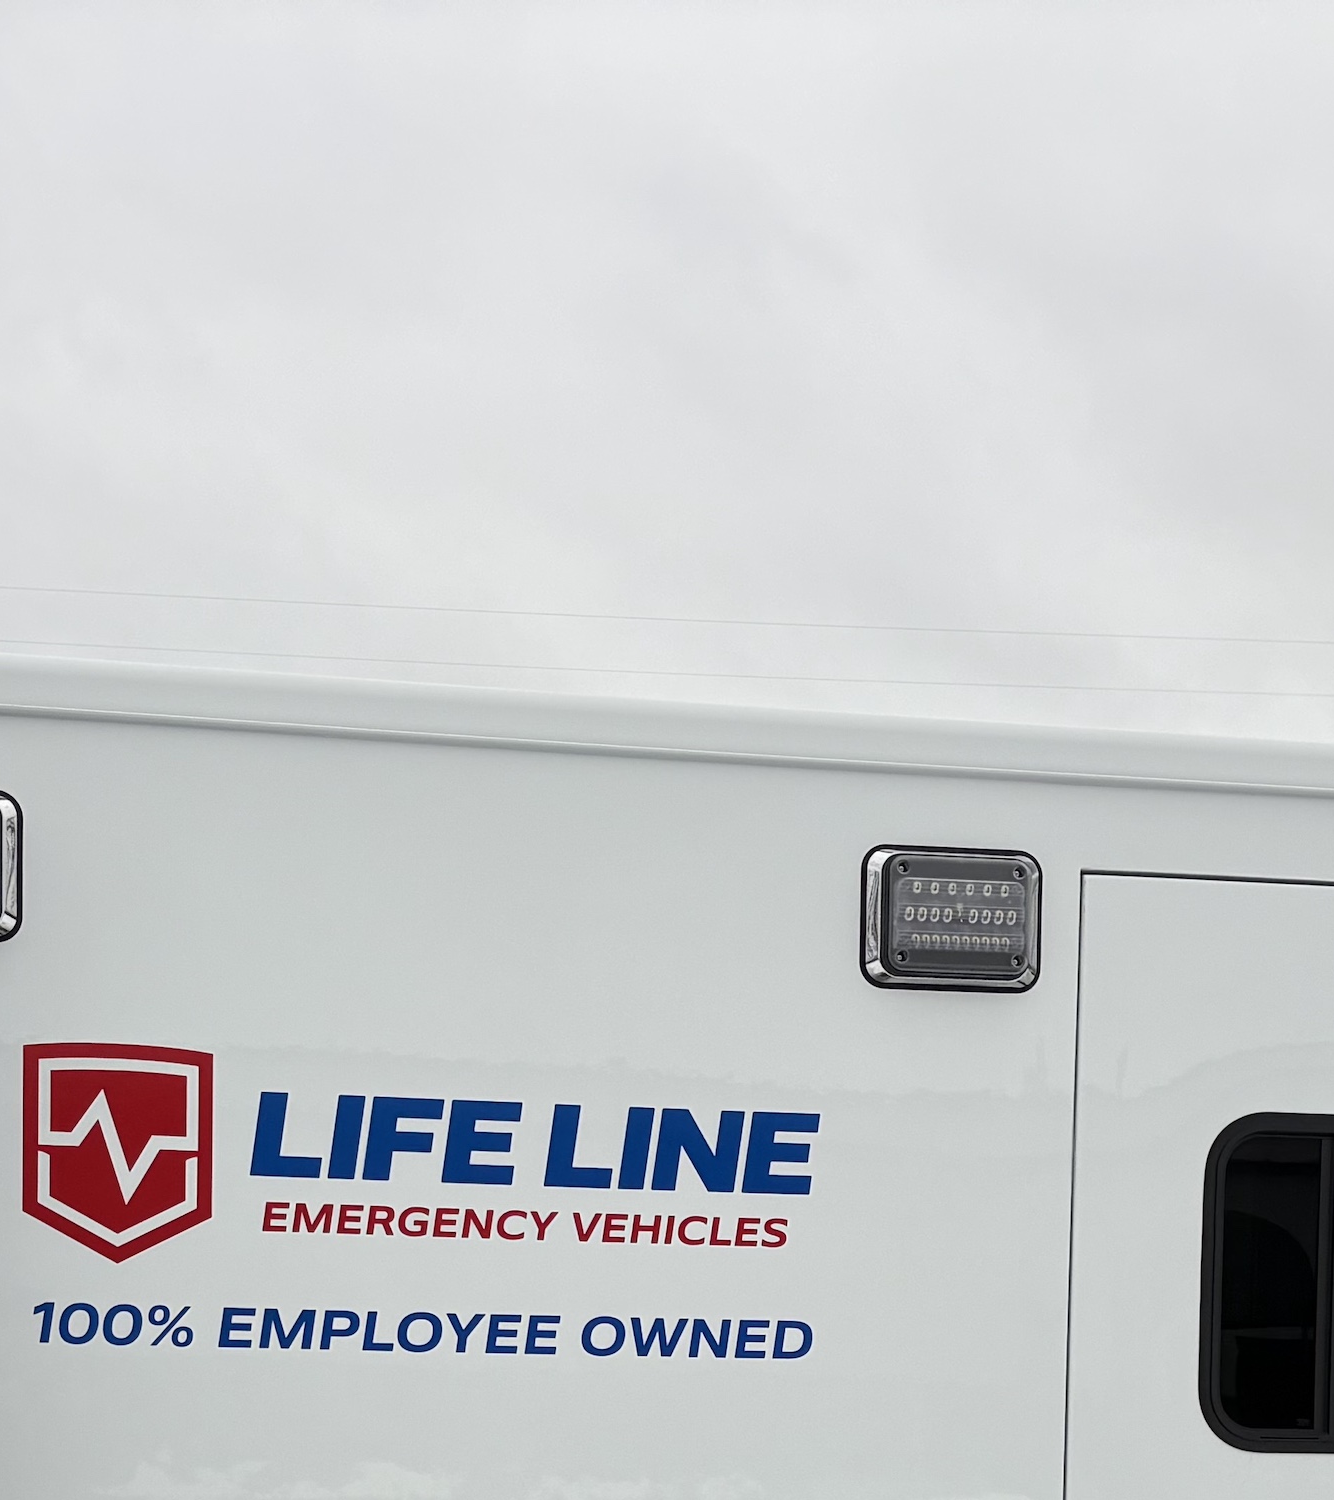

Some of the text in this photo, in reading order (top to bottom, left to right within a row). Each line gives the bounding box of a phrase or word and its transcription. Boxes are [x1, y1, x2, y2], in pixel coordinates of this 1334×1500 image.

[250, 1091, 821, 1196] LIFE LINE
[262, 1201, 789, 1249] EMERGENCY VEHICLES
[31, 1301, 814, 1360] 100% EMPLOYEE OWNED
